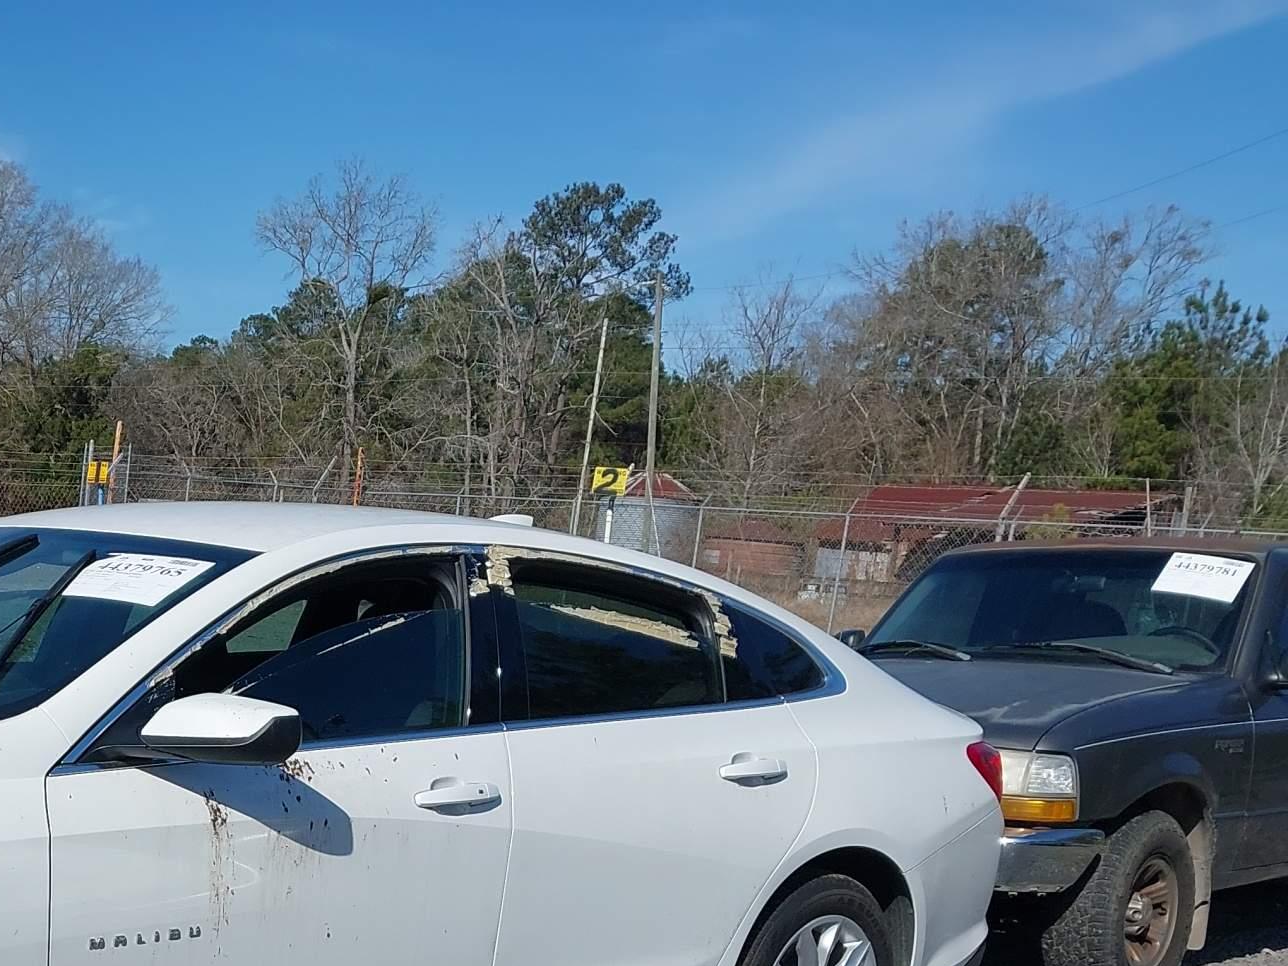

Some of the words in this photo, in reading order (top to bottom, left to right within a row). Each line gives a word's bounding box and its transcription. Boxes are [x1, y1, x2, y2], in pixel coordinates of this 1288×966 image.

[593, 468, 619, 495] 2
[99, 561, 188, 577] 44379765
[1174, 561, 1239, 577] 44379781
[89, 926, 202, 951] MALIBU
